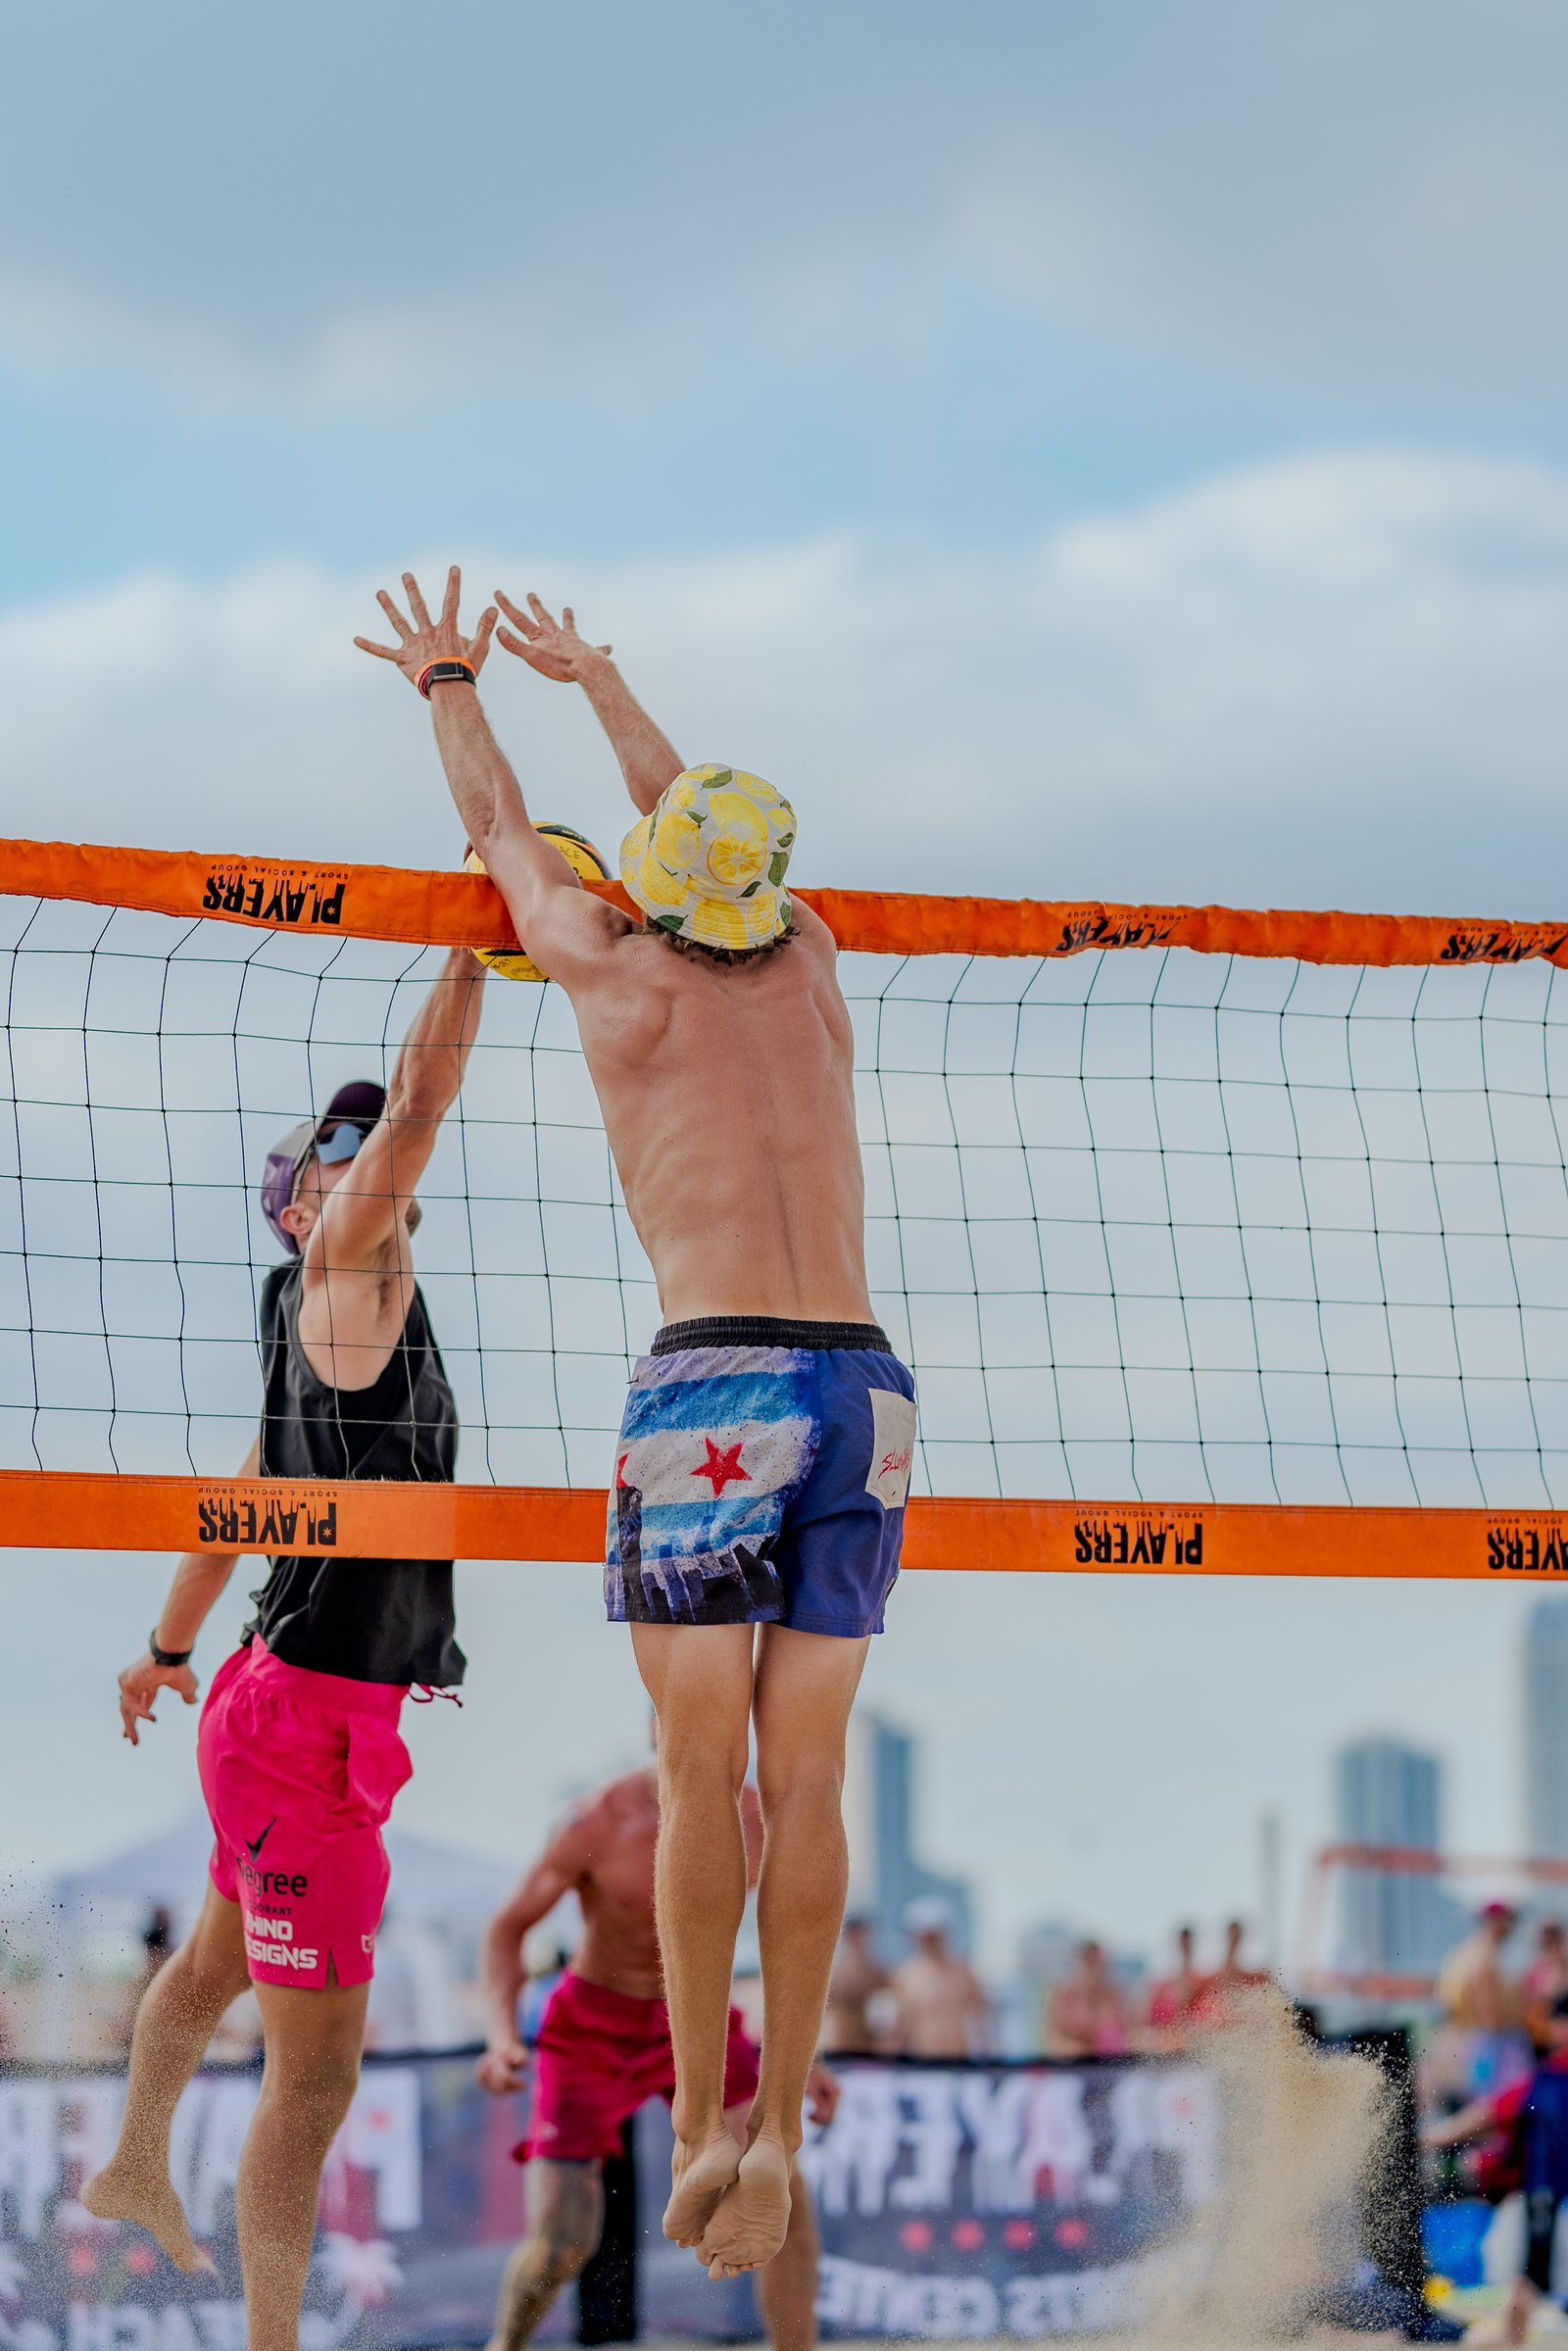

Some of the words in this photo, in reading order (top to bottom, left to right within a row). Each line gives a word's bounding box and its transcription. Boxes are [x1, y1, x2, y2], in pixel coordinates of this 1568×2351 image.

[254, 866, 294, 876] SOCIAL
[315, 871, 348, 880] SPORT
[203, 873, 346, 924] PLAYERS
[199, 1497, 336, 1545] PLAYERS
[1074, 1520, 1202, 1565] PLAYERS
